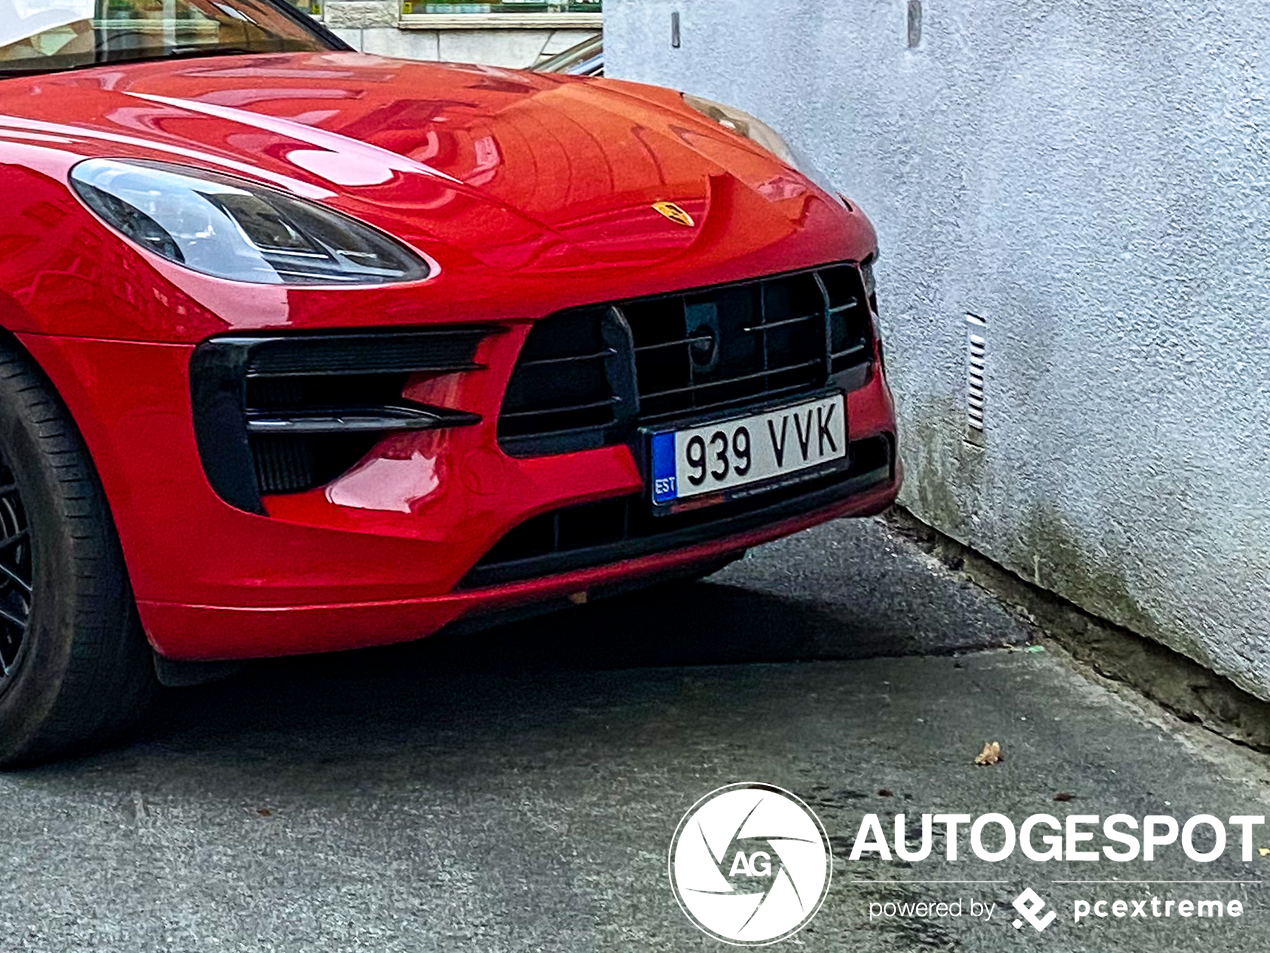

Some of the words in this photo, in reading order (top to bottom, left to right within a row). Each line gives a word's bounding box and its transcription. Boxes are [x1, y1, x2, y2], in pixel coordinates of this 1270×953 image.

[686, 425, 752, 486] 939
[767, 403, 838, 468] VVK
[655, 476, 676, 494] EST
